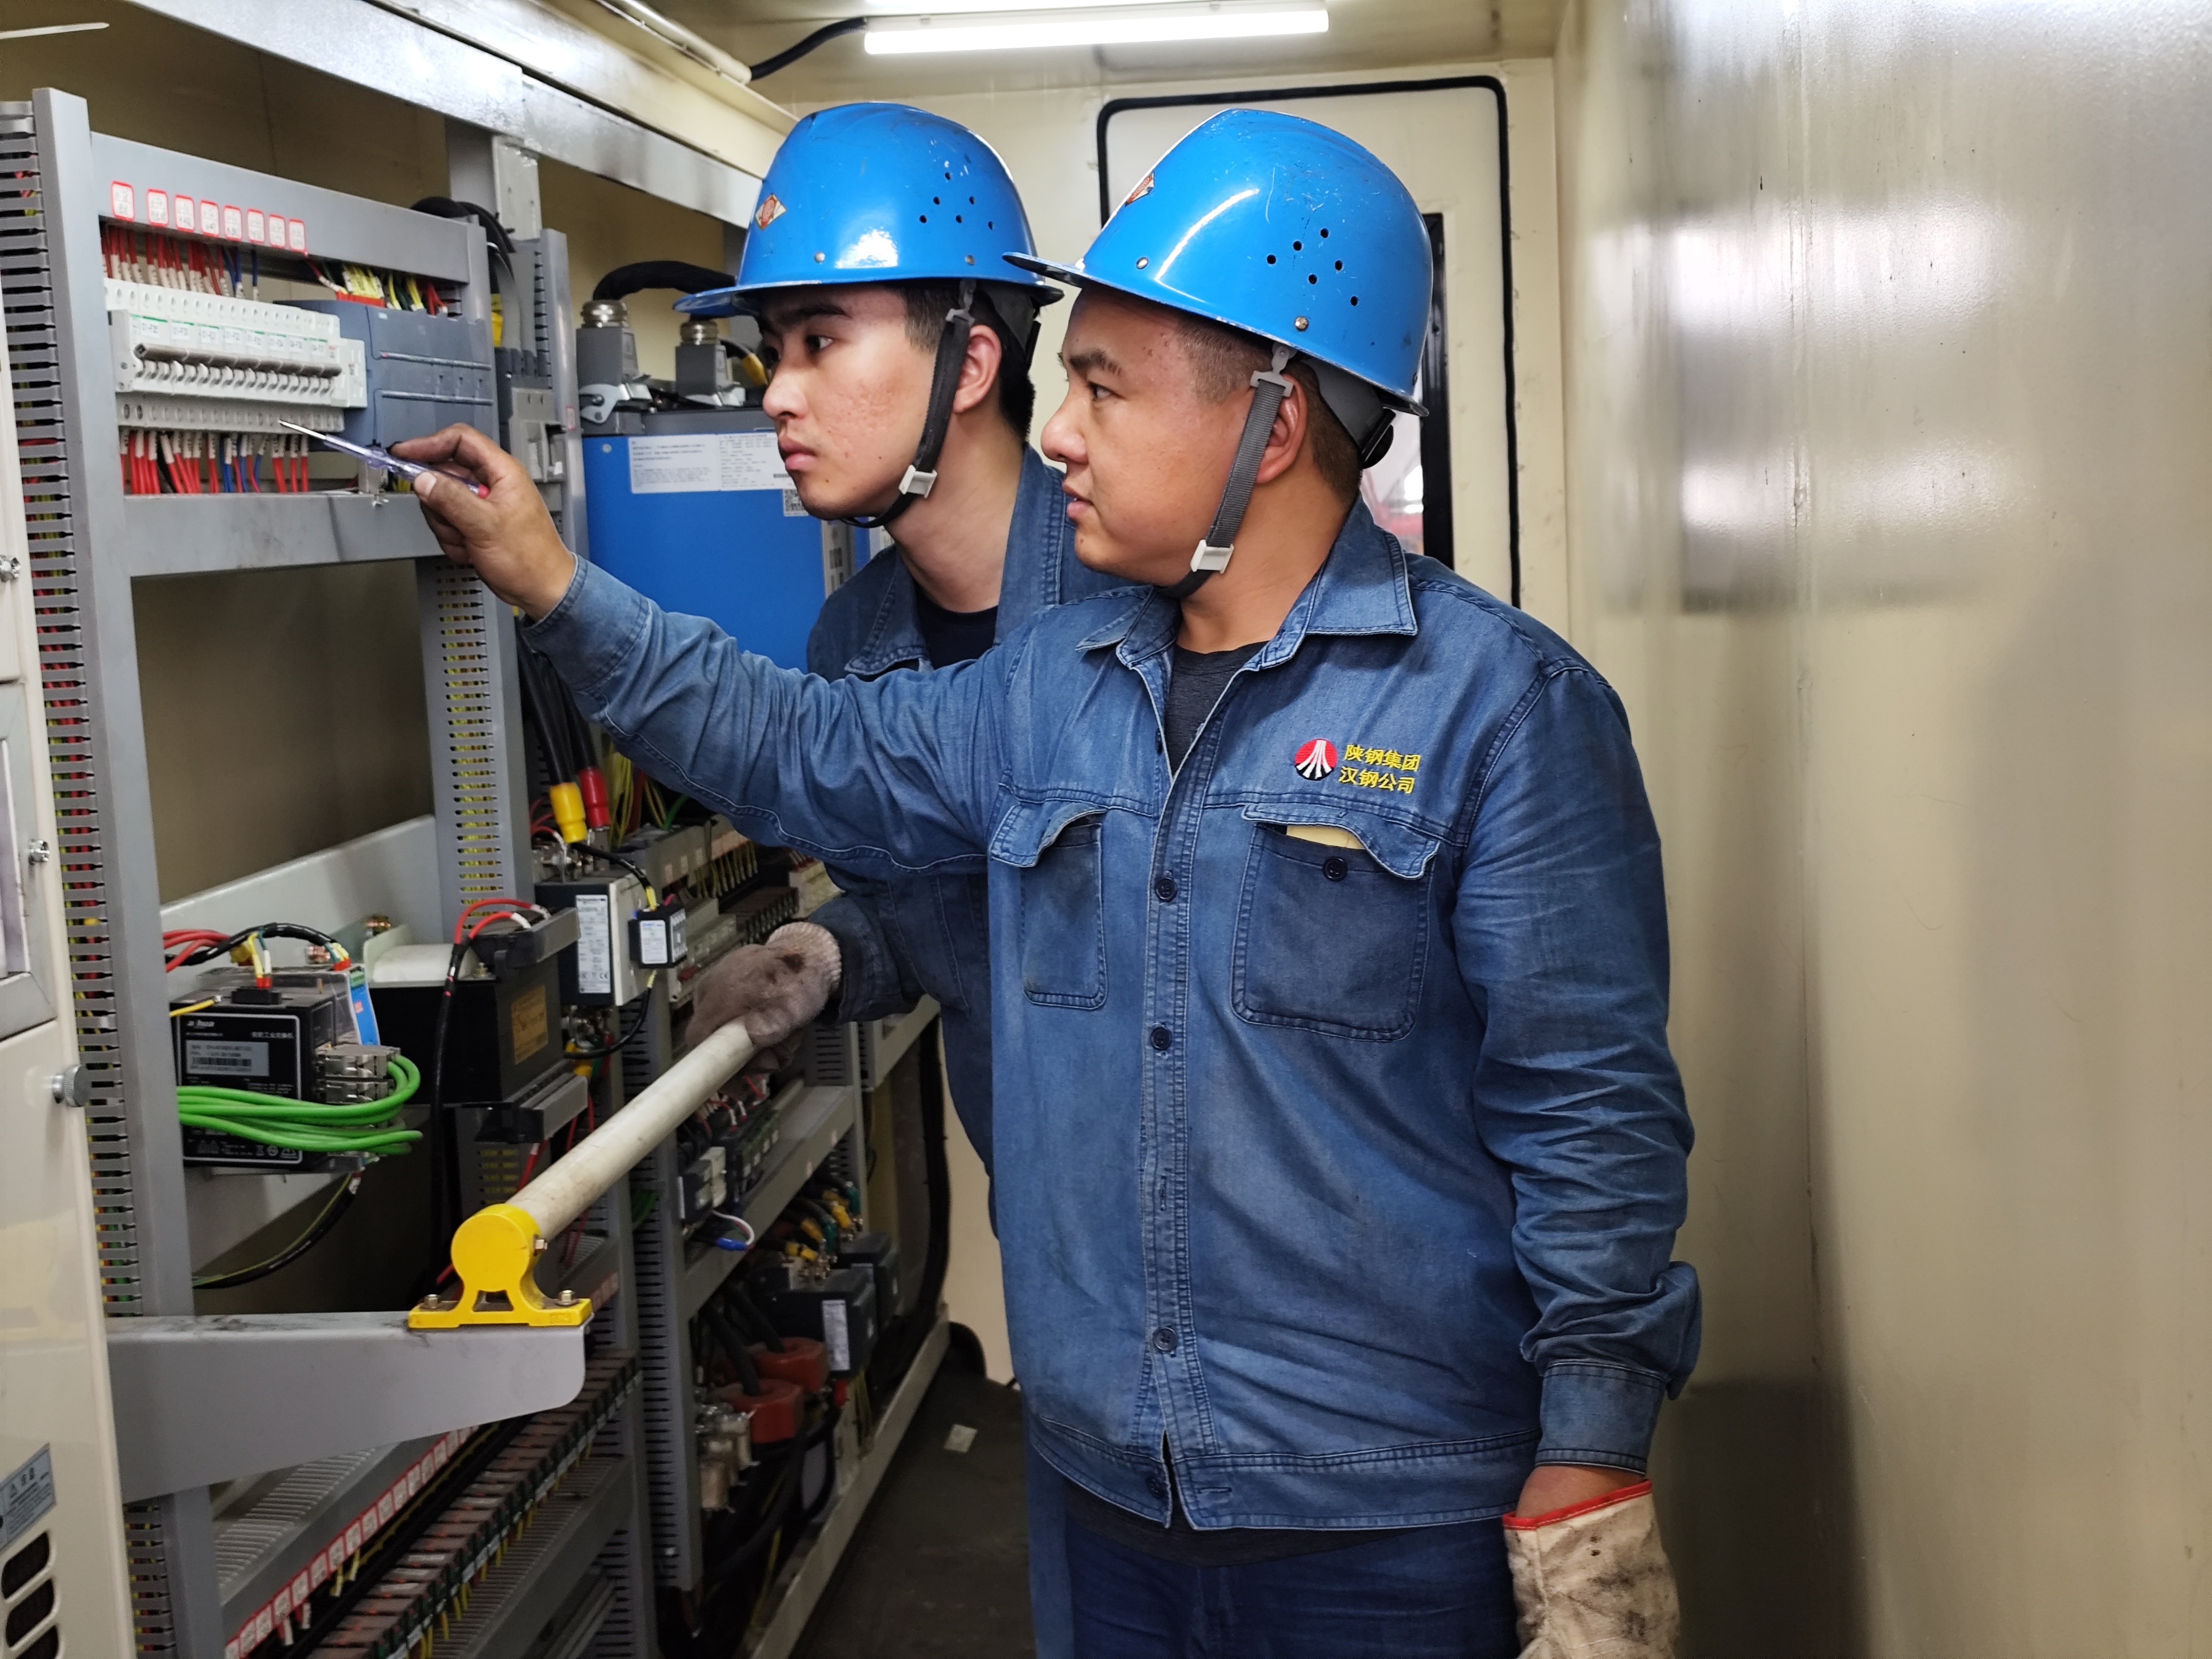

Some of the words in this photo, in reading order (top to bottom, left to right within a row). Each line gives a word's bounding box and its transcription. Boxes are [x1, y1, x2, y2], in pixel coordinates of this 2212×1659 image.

[1344, 744, 1421, 771] 陕钢集团
[1338, 766, 1415, 794] 汉钢公司
